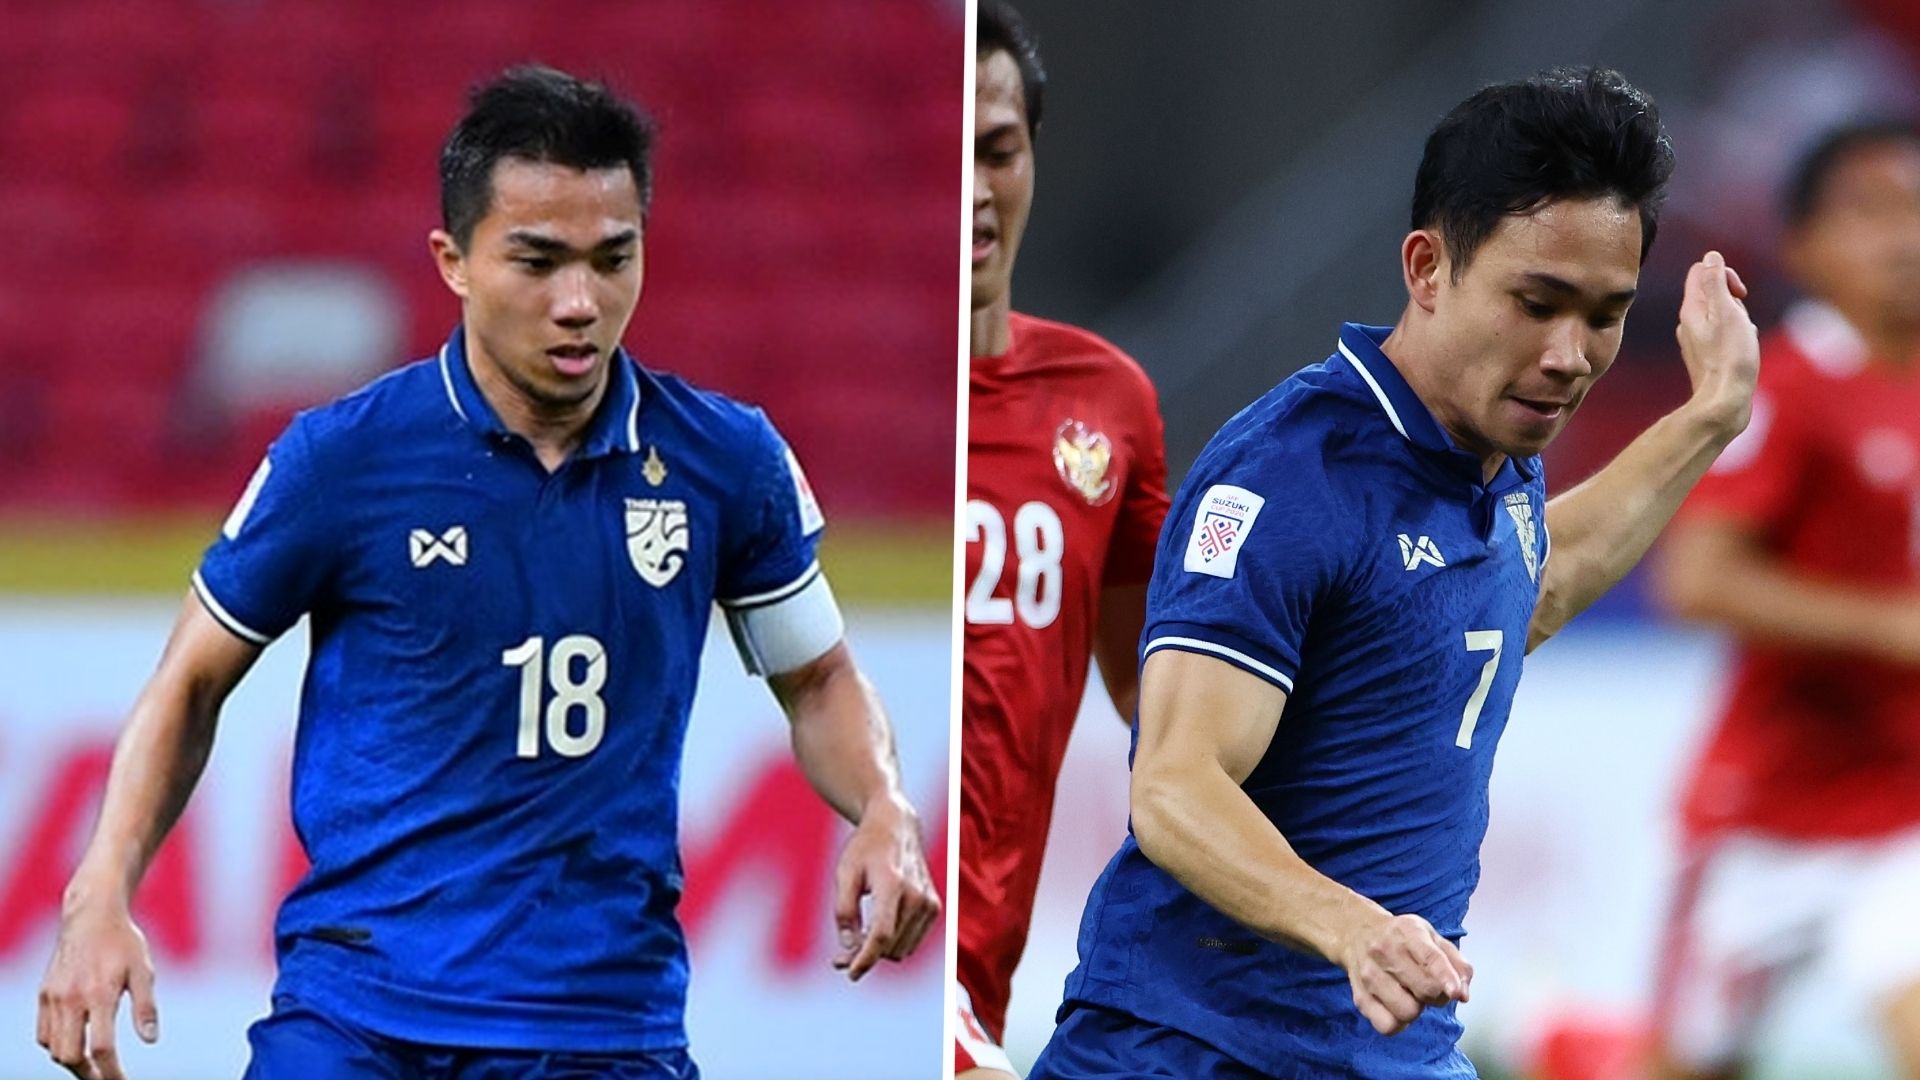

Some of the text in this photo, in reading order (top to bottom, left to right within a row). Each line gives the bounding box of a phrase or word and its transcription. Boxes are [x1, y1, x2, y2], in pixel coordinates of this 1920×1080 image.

[965, 499, 1065, 630] 28
[1211, 497, 1250, 513] SUZUKI
[502, 634, 607, 757] 18
[1455, 629, 1503, 750] 7
